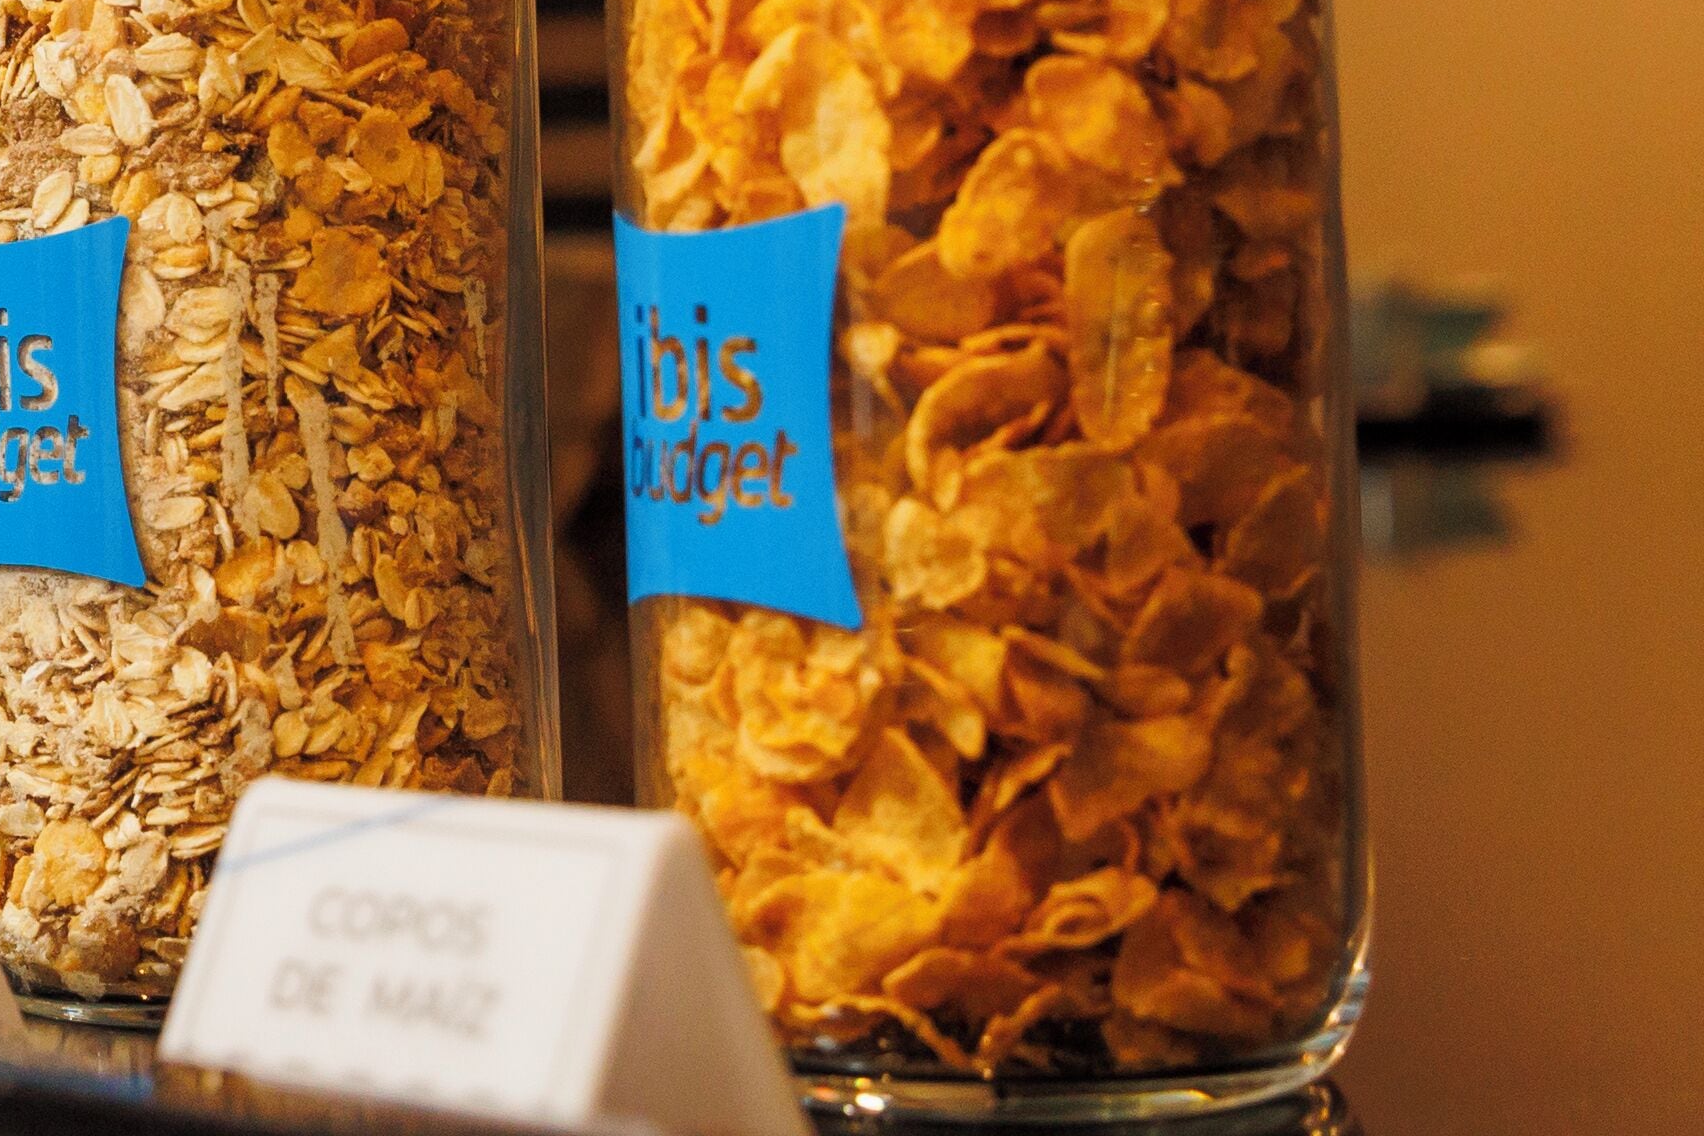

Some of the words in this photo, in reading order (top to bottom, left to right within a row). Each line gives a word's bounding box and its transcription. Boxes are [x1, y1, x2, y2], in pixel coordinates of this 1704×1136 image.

[633, 304, 763, 423] ibis
[630, 416, 798, 526] budget
[307, 884, 495, 958] COPOS
[267, 955, 345, 1017] DE
